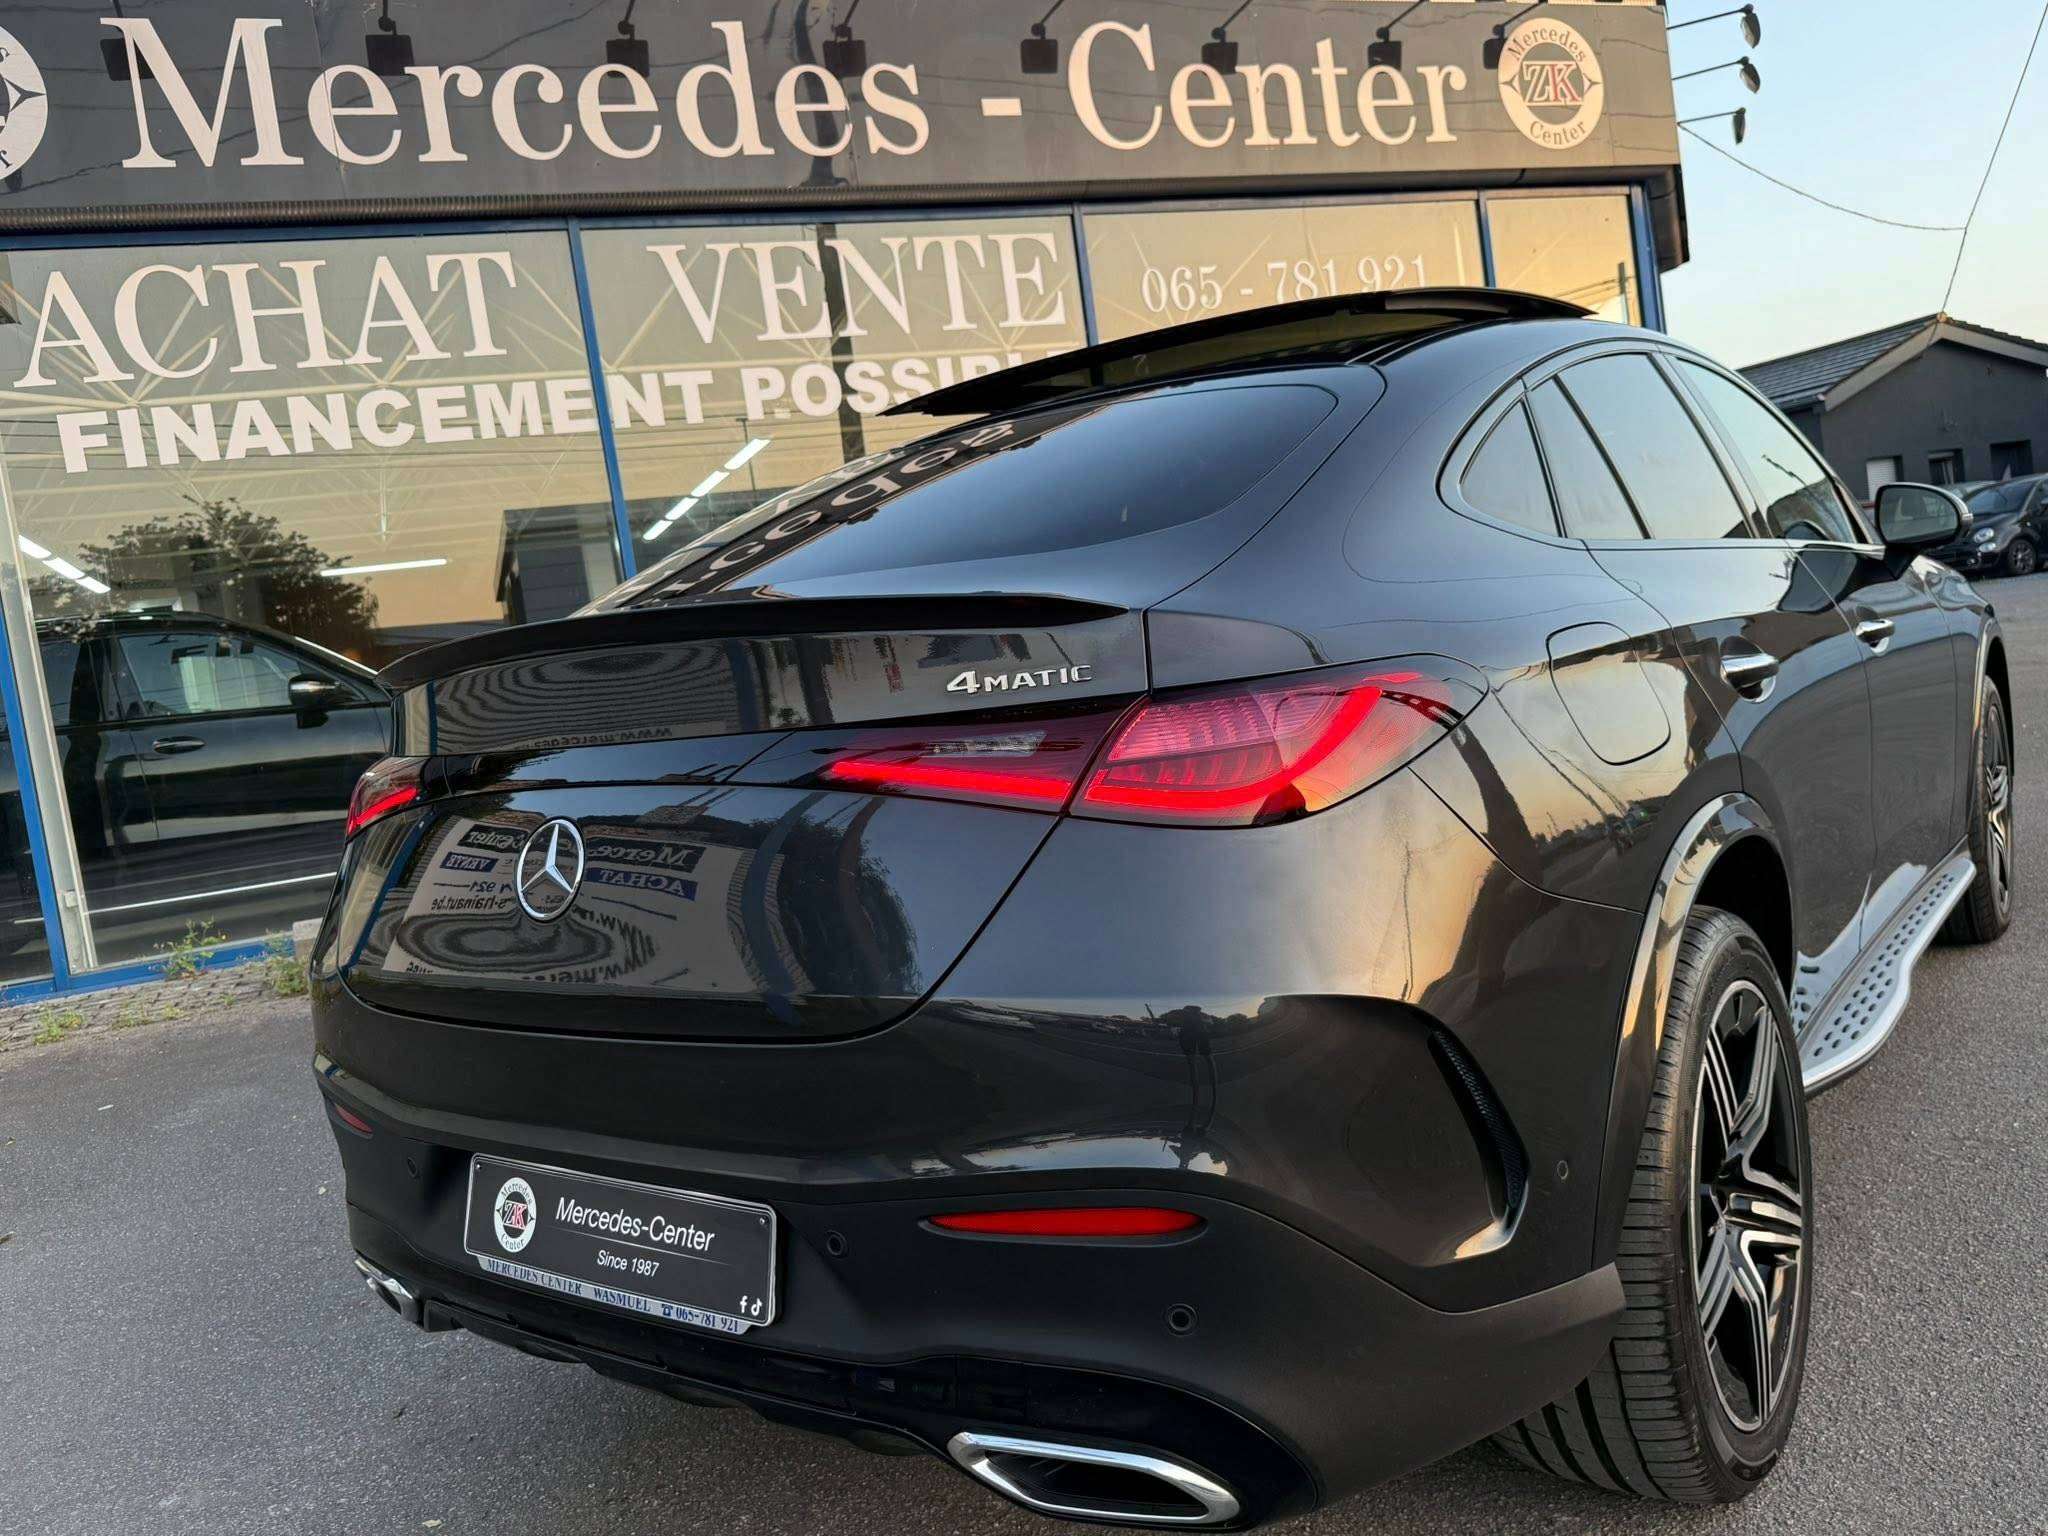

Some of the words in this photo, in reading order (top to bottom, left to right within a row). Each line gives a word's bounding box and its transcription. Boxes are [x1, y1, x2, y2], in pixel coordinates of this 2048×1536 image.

[1507, 27, 1587, 62] Mercedes
[100, 17, 930, 169] Mercedes
[1066, 20, 1467, 151] Center
[1529, 119, 1587, 146] Center
[645, 232, 1067, 345] VENTE
[1141, 264, 1224, 313] 065
[1266, 258, 1339, 304] 781
[1356, 254, 1428, 293] 921
[13, 250, 517, 388] ACHAT
[56, 371, 714, 474] FINANCEMENT
[740, 350, 1084, 422] POSSI
[946, 664, 1093, 694] 4MATIC
[555, 1196, 715, 1252] Mercedes-Center
[486, 1258, 539, 1284] MERCEDES
[540, 1271, 583, 1295] CENTER
[593, 1288, 651, 1313] WASMUEL
[596, 1249, 628, 1272] Since
[630, 1256, 660, 1278] 1987
